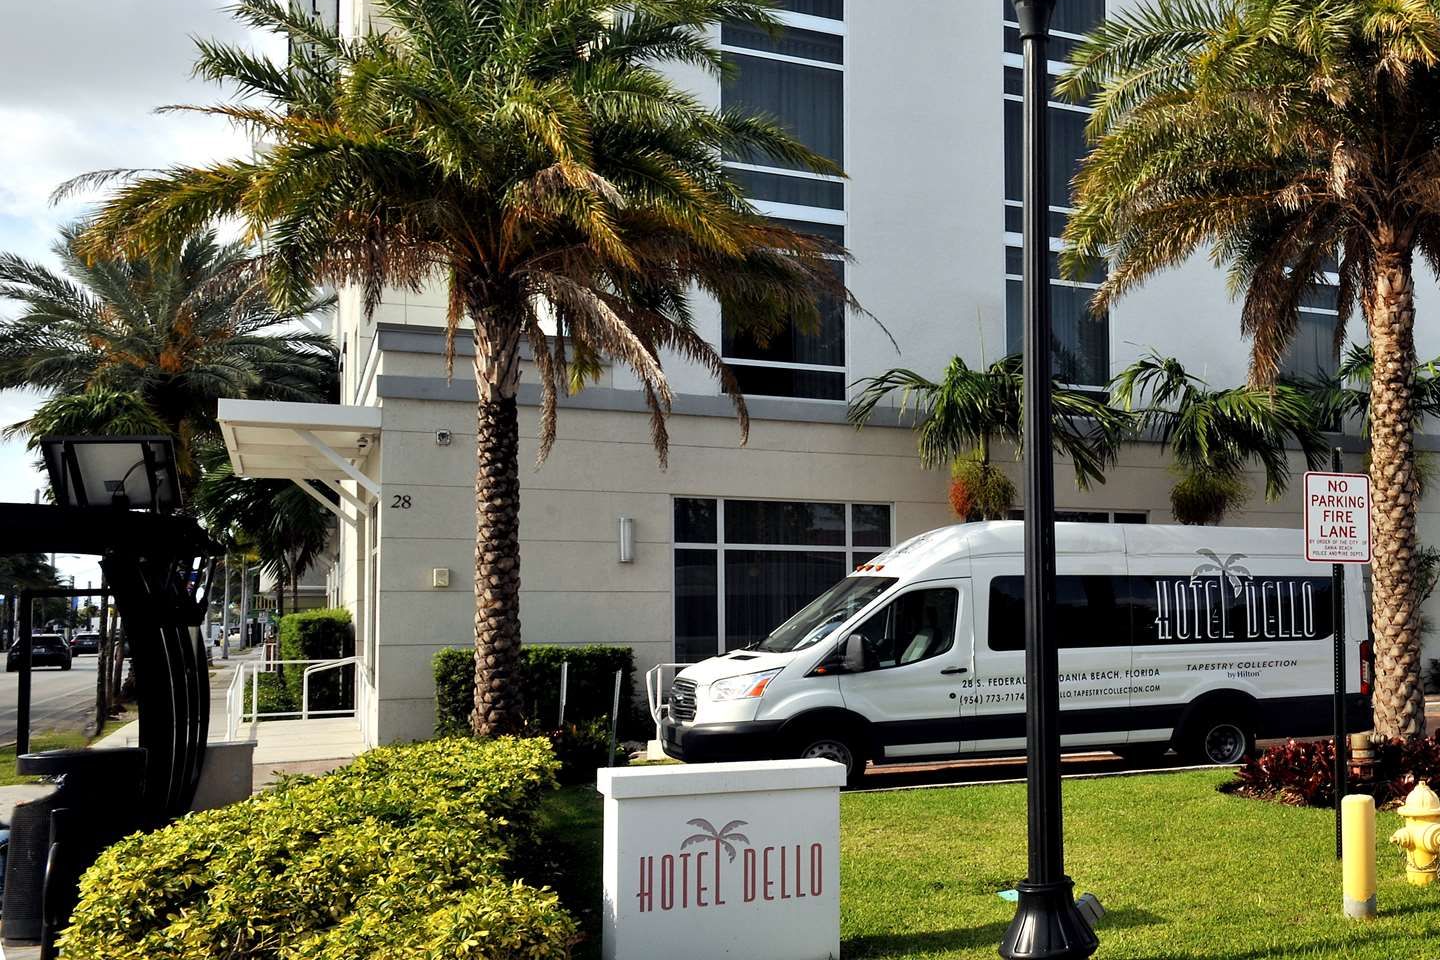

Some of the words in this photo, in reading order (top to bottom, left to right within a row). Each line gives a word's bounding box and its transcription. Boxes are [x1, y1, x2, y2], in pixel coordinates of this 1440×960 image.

[1328, 480, 1348, 493] NO
[391, 494, 413, 510] 28
[1311, 494, 1365, 509] PARKING
[1323, 510, 1353, 523] FIRE
[1320, 525, 1357, 538] LANE
[1154, 572, 1234, 641] HOTEL
[1245, 581, 1317, 639] DELLO
[1186, 663, 1234, 672] TAPESTRY
[1237, 660, 1298, 670] COLLECTION
[962, 680, 973, 689] 28
[1059, 672, 1087, 682] DANIA
[1090, 670, 1123, 681] BEACH,
[1125, 668, 1161, 678] FLORIDA
[959, 694, 983, 705] (954)
[986, 692, 1025, 703] 773-7174
[1059, 685, 1161, 699] LLO.TAPESTRYCOLLECTION.COM
[636, 837, 726, 913] HOTEL
[743, 842, 823, 903] DELLO
